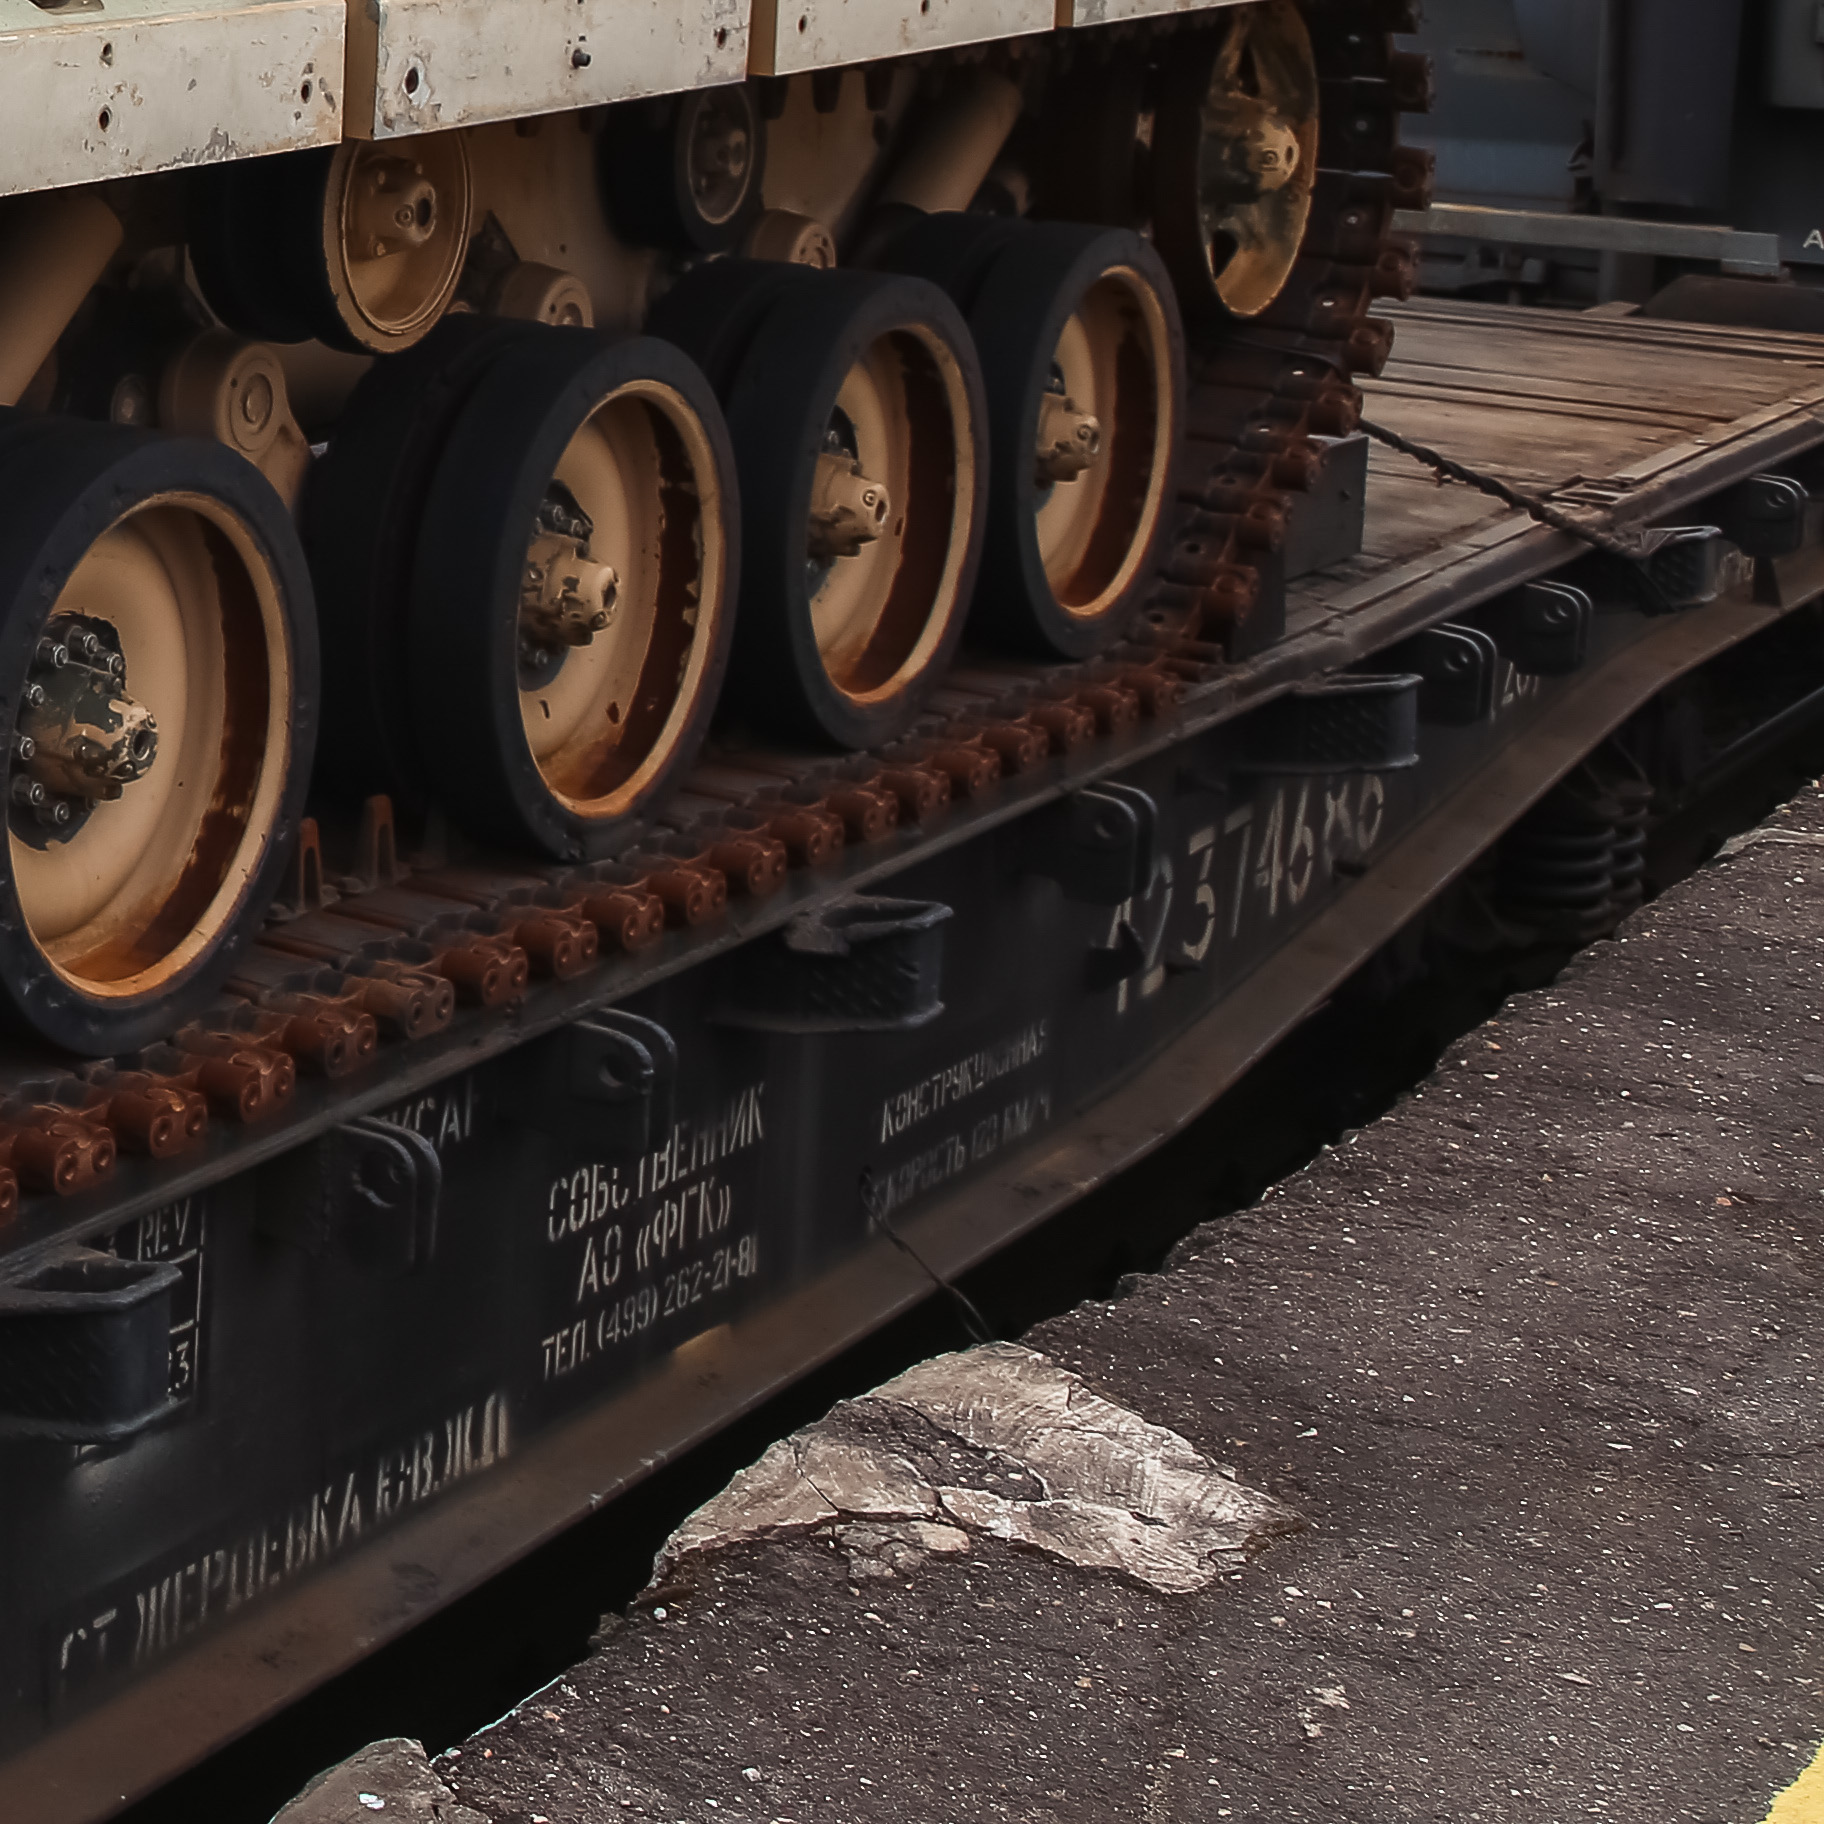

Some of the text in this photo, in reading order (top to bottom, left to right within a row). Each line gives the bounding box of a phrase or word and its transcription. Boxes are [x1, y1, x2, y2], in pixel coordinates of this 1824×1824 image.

[577, 1176, 732, 1303] АО «ФГК»
[598, 1283, 658, 1351] (499)
